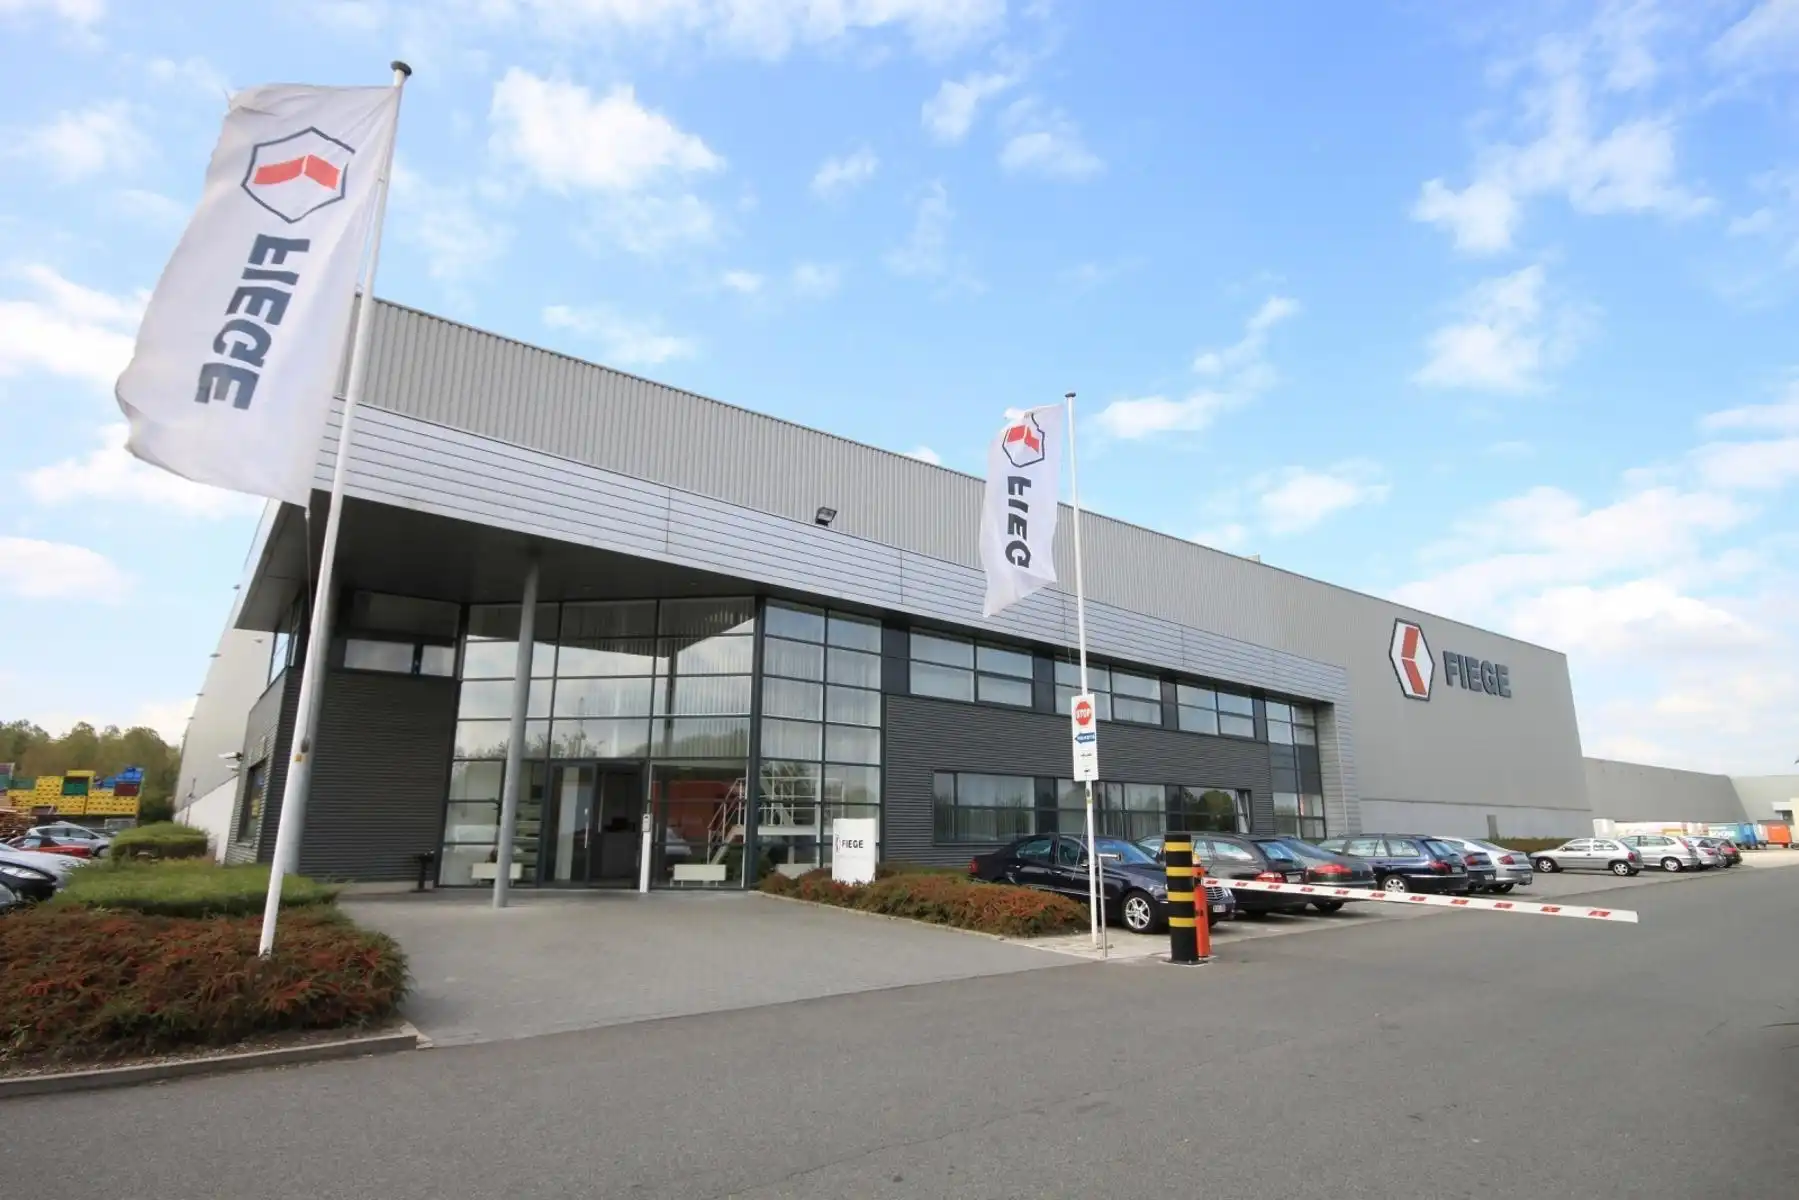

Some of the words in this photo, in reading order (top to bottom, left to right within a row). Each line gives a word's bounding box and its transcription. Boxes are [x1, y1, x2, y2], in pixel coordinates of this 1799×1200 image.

[195, 234, 310, 410] FIEGE
[1442, 650, 1511, 698] FIEGE
[841, 839, 864, 849] FIEGE
